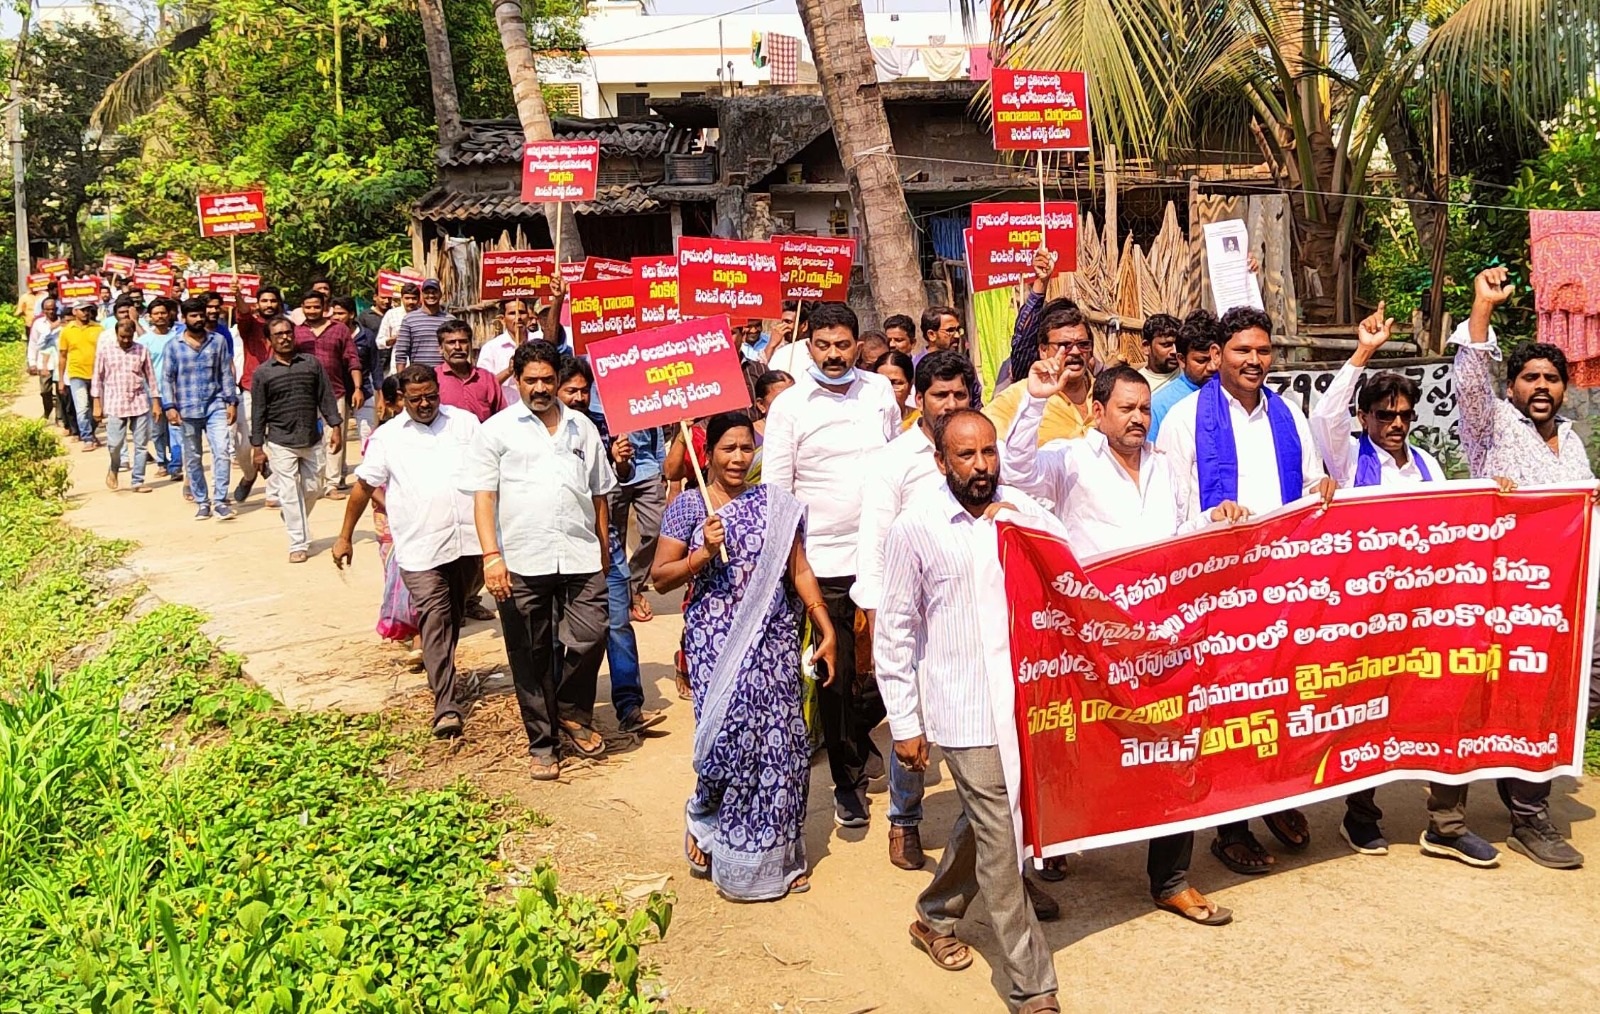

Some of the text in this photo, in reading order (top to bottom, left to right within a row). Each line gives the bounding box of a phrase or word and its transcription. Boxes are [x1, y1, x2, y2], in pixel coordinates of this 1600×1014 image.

[976, 211, 1009, 230] గ్రామంలో
[680, 247, 713, 267] గ్రామంలో
[713, 251, 747, 267] అలజడులు
[990, 247, 1014, 263] వెంటనే
[1015, 248, 1034, 266] అరెస్ట్
[712, 269, 748, 289] దుర్గను
[641, 304, 665, 323] వెంటనే
[694, 287, 763, 309] వెంటనే అరెస్ట్ చేయాలి
[580, 316, 604, 335] వెంటనే
[604, 316, 623, 336] అరెస్ట్
[595, 343, 640, 378] గ్రామంలో
[640, 338, 688, 363] అలజడులు
[645, 360, 695, 387] దుర్గను
[628, 379, 722, 416] వెంటనే అరెస్ట్ చేయాలి
[1169, 551, 1240, 586] అంటూ
[1242, 529, 1353, 567] సామాజిక
[1356, 513, 1517, 556] మాధ్యమాలలో
[1178, 585, 1258, 627] పెడుతూ
[1262, 577, 1342, 607] అసత్య
[1491, 556, 1552, 591] చేస్తూ
[1191, 618, 1290, 667] గ్రామంలో
[1293, 611, 1409, 648] అశాంతిని
[1080, 694, 1184, 726] రాంబాబు
[1294, 644, 1442, 701] బైనపాలపు
[1508, 645, 1549, 675] ను
[1119, 695, 1390, 768] వెంటనే అరెస్ట్ చేయాలి
[1340, 740, 1382, 772] గ్రామ
[1382, 736, 1441, 762] ప్రజలు
[1457, 732, 1559, 759] గొరగనమూడి
